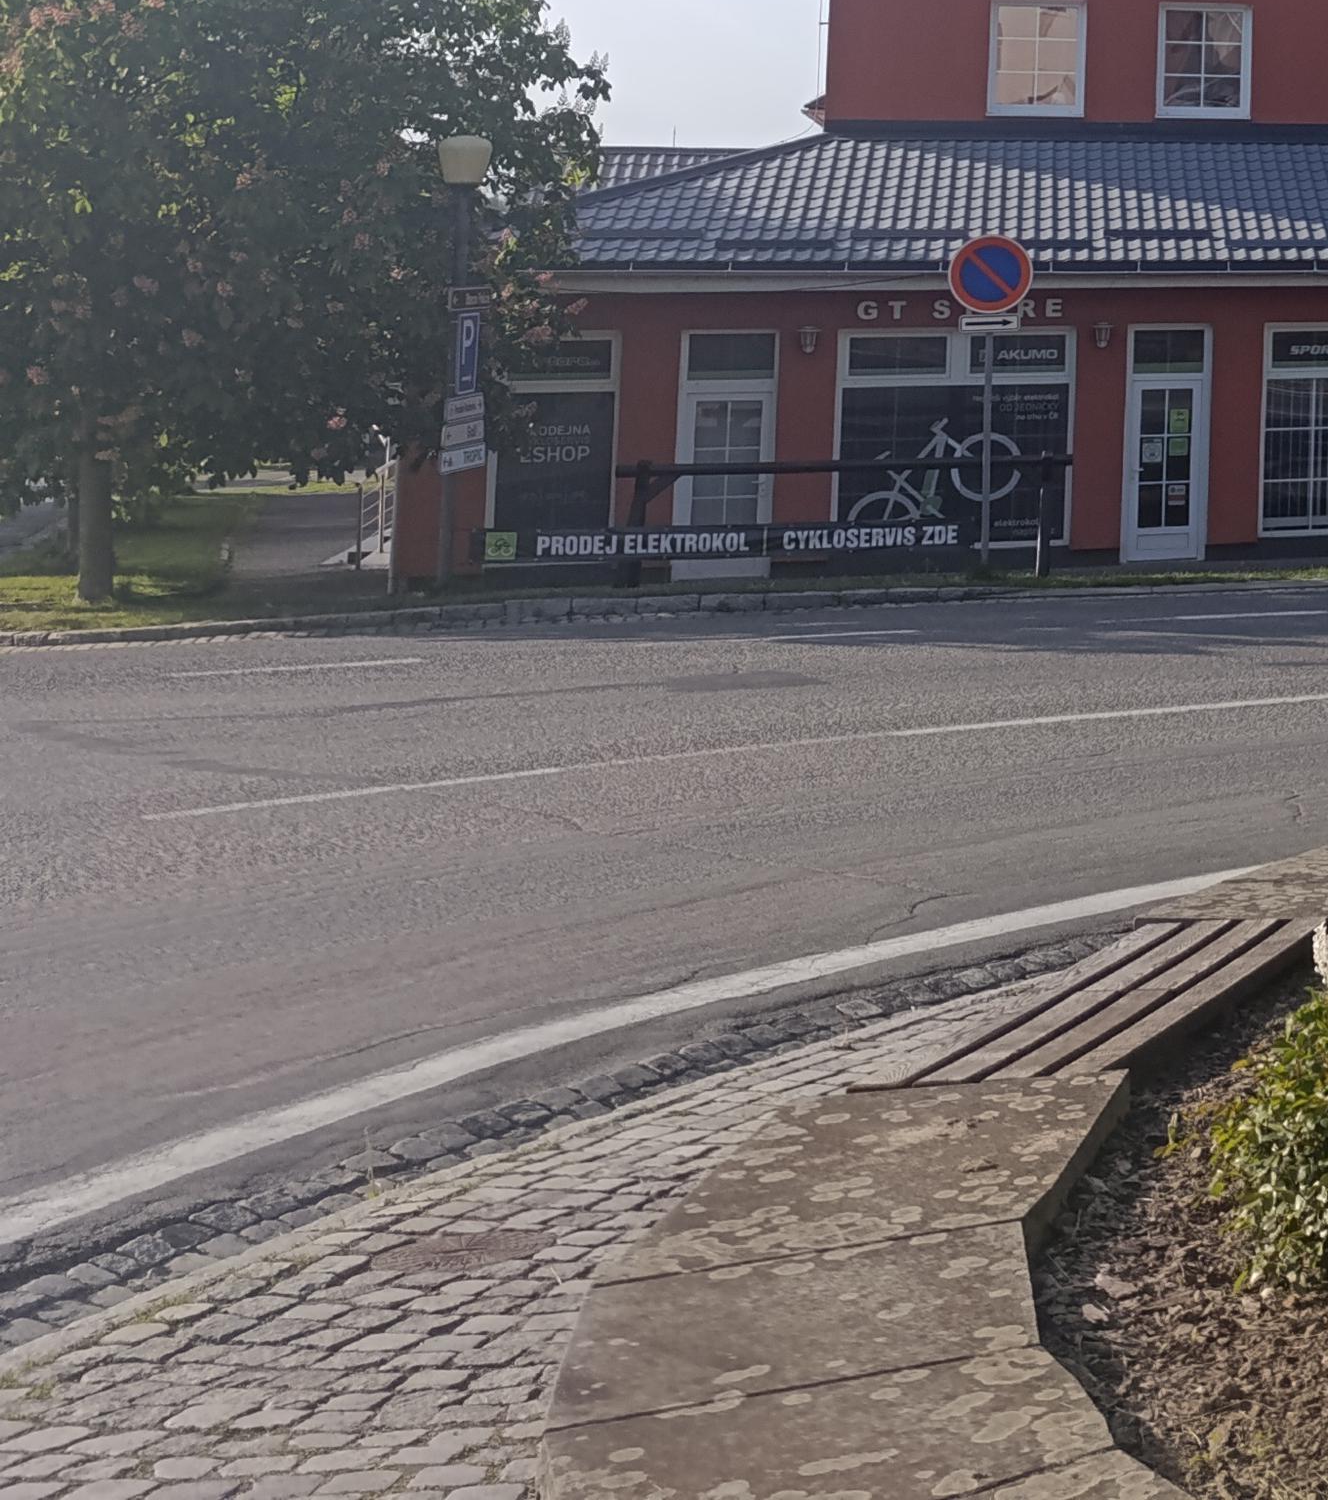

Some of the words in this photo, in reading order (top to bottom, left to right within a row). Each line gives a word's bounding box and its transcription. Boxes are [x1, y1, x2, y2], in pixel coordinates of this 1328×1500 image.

[857, 299, 908, 320] GT
[931, 298, 1063, 319] SRE
[462, 319, 475, 365] P
[996, 349, 1059, 361] AKUMO
[530, 424, 592, 438] ODEJNA
[536, 534, 618, 556] PRODEJ
[623, 531, 750, 555] ELEKTROKOL
[782, 526, 916, 550] CYKLOSERVIS
[921, 525, 959, 545] ZDE
